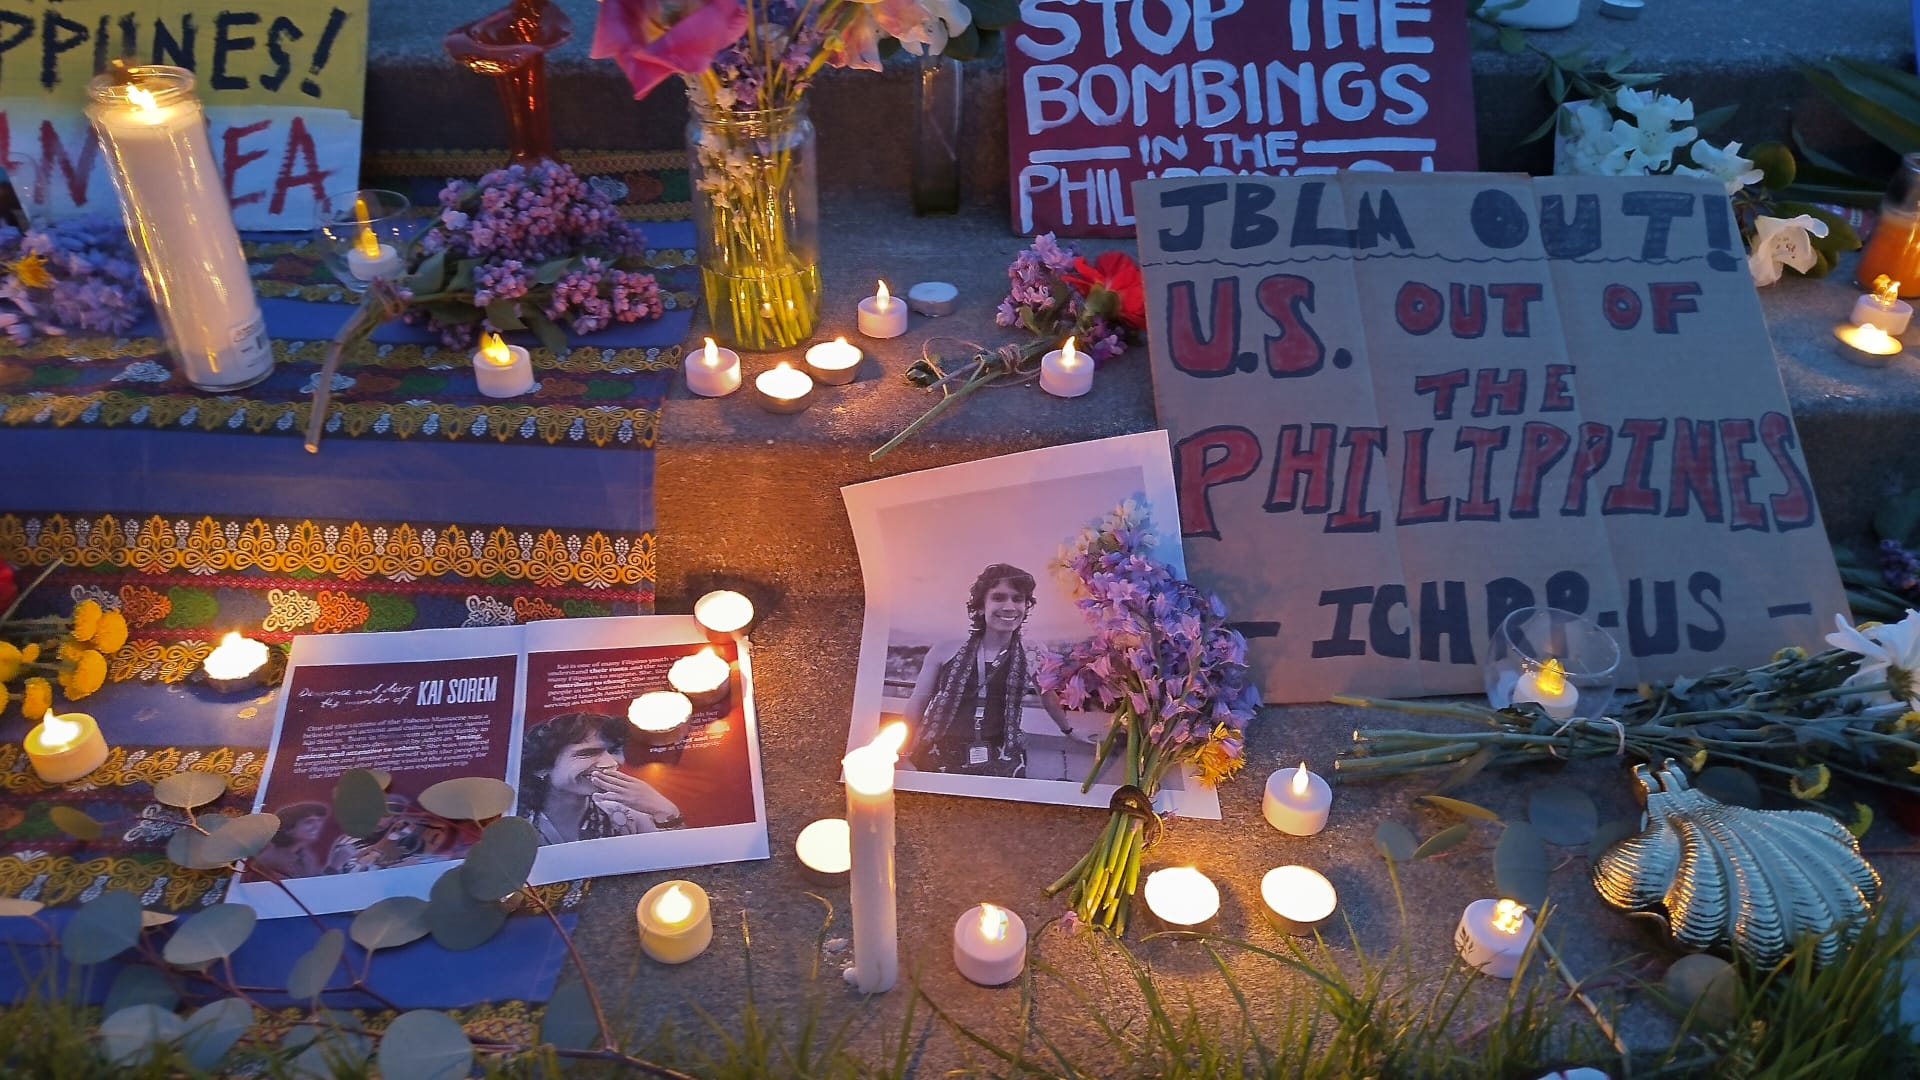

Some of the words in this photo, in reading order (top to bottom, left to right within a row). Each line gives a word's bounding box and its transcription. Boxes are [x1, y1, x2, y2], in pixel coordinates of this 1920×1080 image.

[1016, 0, 1243, 60] STOP
[1289, 0, 1434, 53] THE
[1022, 59, 1431, 134] BOMBINGS
[1138, 133, 1187, 165] IN
[1203, 131, 1298, 167] THE
[1157, 181, 1415, 252] JBLM
[1471, 188, 1741, 272] OUT!
[1165, 273, 1352, 379] U.S.
[1395, 281, 1542, 338] OUT
[1603, 281, 1701, 335] OF
[1414, 364, 1576, 419] THE
[1177, 411, 1815, 541] PHILIPPINES
[416, 680, 444, 706] KAI
[447, 676, 499, 704] SOREM
[553, 681, 592, 689] contribute
